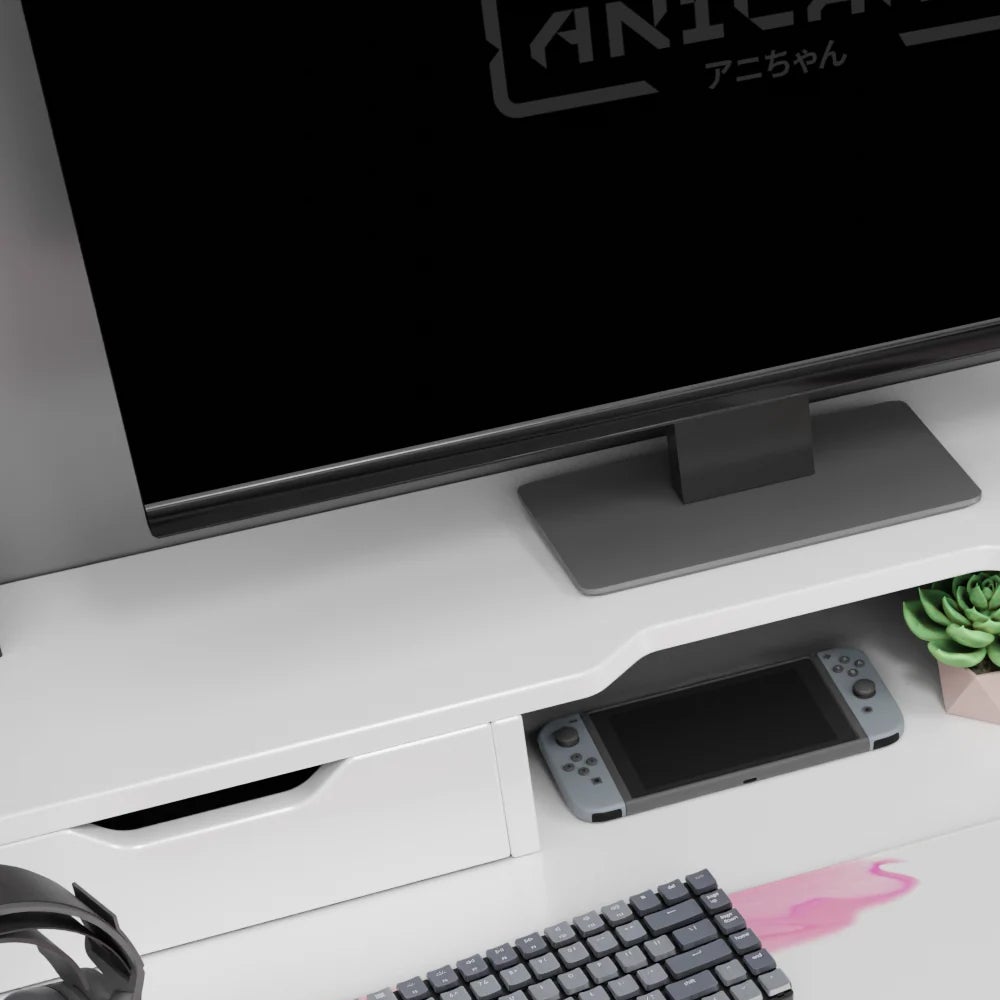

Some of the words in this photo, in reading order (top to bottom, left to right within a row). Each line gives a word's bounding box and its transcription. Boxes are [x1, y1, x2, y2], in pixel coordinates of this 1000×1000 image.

[705, 40, 847, 89] アニちゃん
[734, 932, 750, 941] home
[752, 952, 763, 960] end
